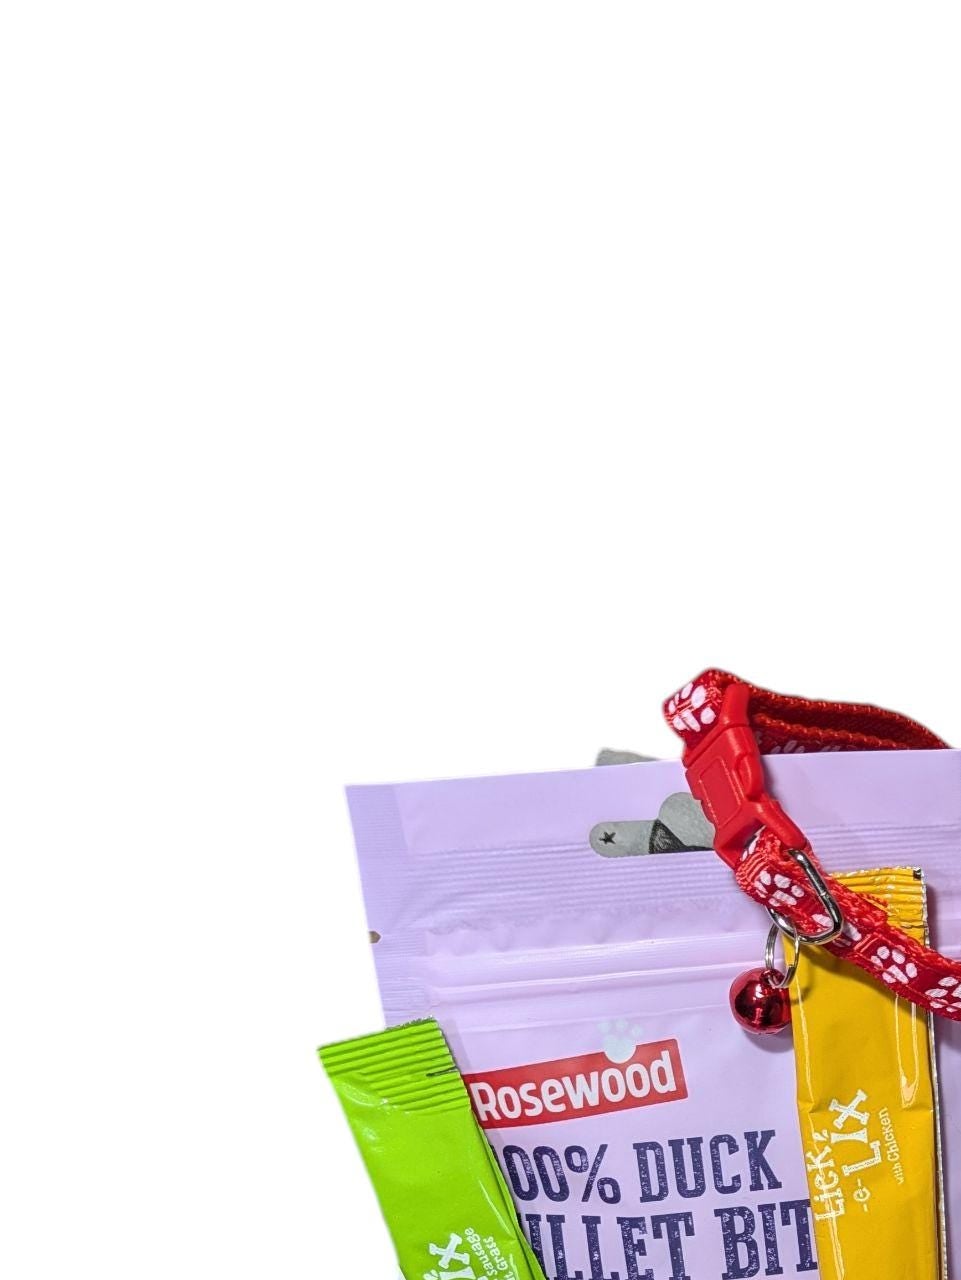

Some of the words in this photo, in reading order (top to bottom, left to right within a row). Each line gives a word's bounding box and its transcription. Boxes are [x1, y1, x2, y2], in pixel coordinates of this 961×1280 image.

[469, 1050, 677, 1122] Rosewood
[879, 1107, 900, 1161] Chicken
[491, 1144, 621, 1204] 00%
[633, 1129, 782, 1203] DUCK
[891, 1162, 905, 1185] with
[483, 1236, 508, 1271] Grass
[714, 1198, 818, 1280] BIT
